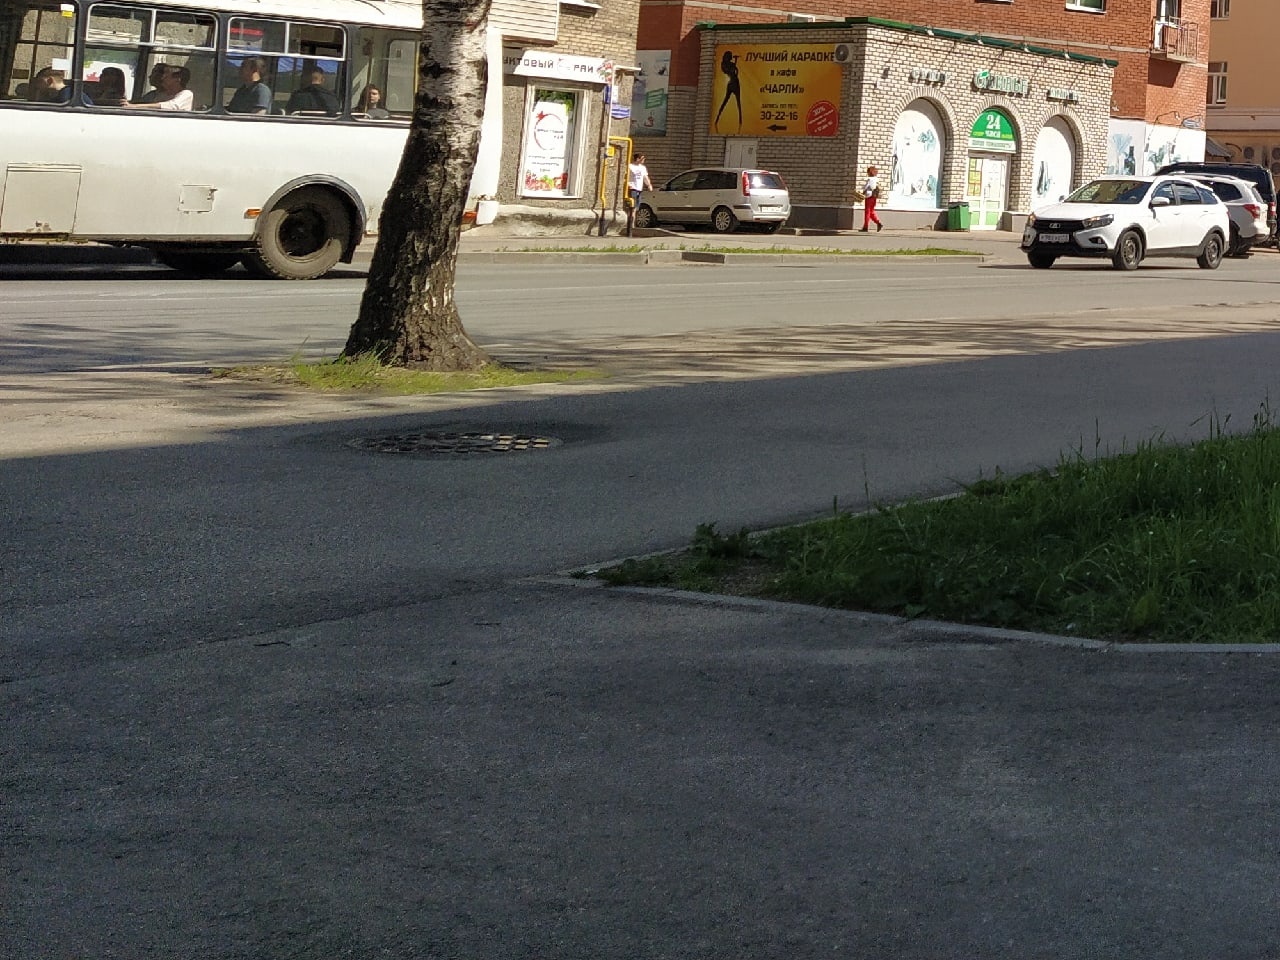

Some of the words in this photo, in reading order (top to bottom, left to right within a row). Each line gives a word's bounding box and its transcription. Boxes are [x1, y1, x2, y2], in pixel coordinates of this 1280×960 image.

[745, 50, 789, 62] ЛУЧШИЙ
[791, 51, 835, 62] КАРАОКЕ
[760, 111, 799, 121] 30-22-16
[986, 114, 1001, 129] 24
